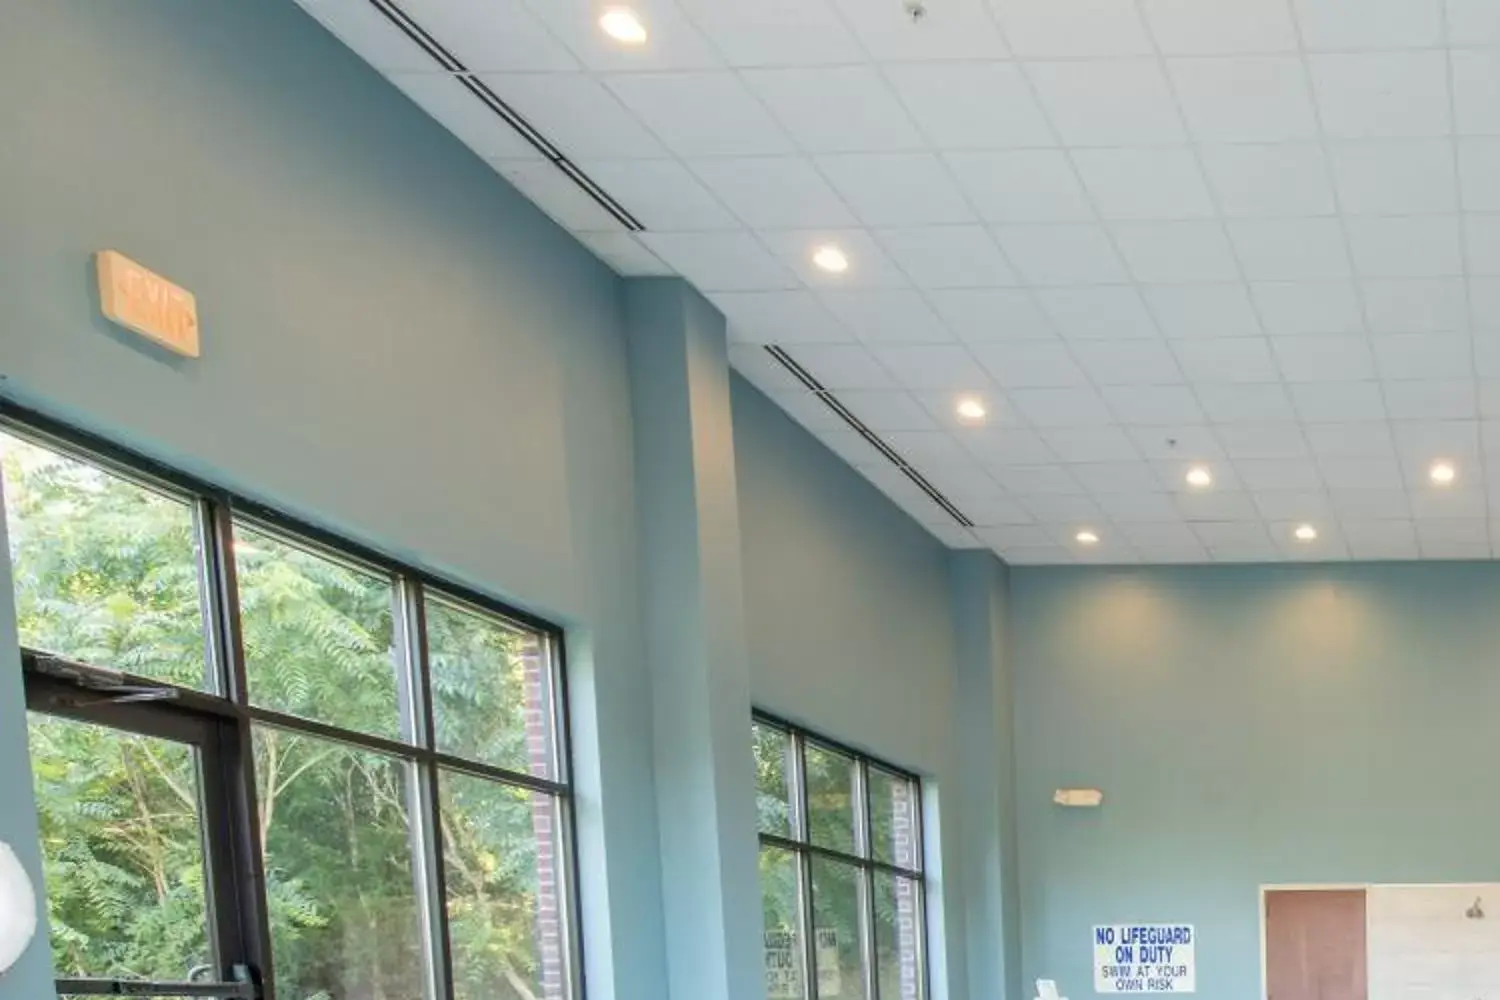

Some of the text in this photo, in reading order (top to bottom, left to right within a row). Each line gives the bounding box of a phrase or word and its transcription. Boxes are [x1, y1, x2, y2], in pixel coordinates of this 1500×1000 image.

[1096, 928, 1191, 944] NO LIFEGUARD
[1115, 946, 1173, 963] ON DUTY
[1102, 965, 1187, 978] SWIM AT YOUR
[1115, 978, 1173, 990] OWN RISK
